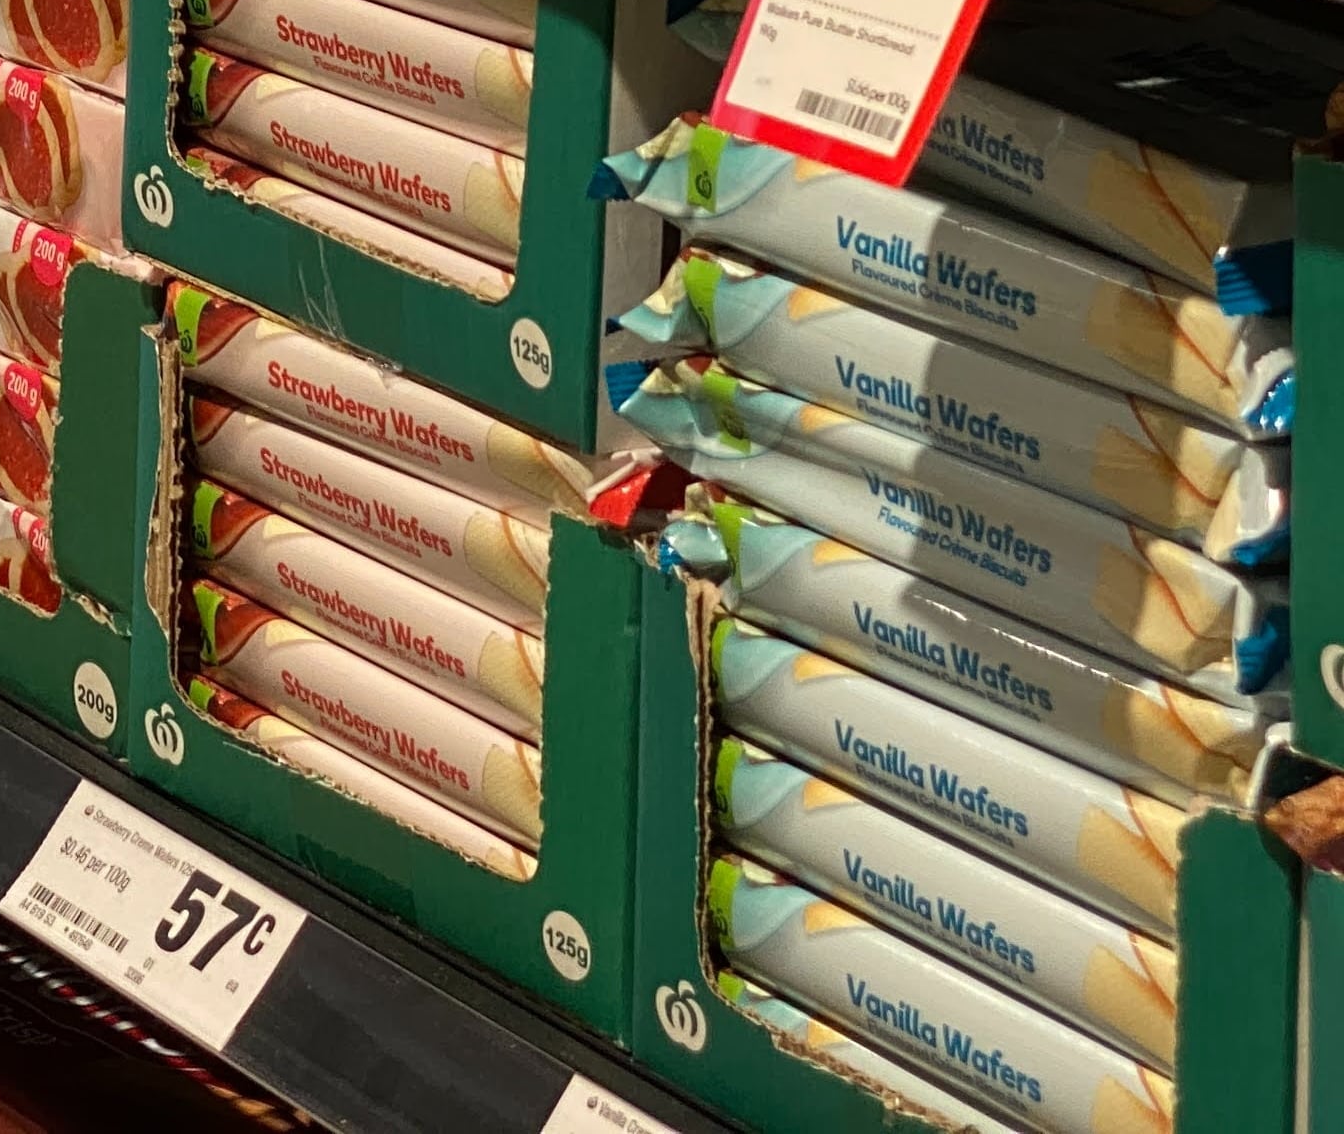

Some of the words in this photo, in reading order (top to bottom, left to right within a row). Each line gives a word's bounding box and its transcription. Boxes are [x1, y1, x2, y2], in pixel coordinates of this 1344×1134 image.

[277, 14, 385, 79] Strawberry
[270, 120, 375, 187] Strawberry
[836, 215, 930, 276] Vanilla
[936, 252, 1036, 317] Wafers
[514, 335, 550, 373] 125g
[268, 361, 386, 430] Strawberry
[835, 355, 932, 419] Vanilla
[937, 395, 1040, 462] Wafers
[260, 448, 370, 523] Strawberry
[866, 468, 953, 531] Vanilla
[956, 503, 1052, 574] Wafers
[277, 563, 387, 638] Strawberry
[853, 602, 946, 669] Vanilla
[952, 644, 1052, 712] Wafers
[78, 684, 114, 722] 200g
[835, 719, 924, 790] Vanilla
[931, 769, 1028, 838] Wafers
[60, 837, 88, 864] $0.46
[85, 855, 105, 876] per
[104, 865, 130, 893] 100g
[546, 930, 588, 967] 125g
[843, 849, 933, 921] Vanilla
[939, 899, 1034, 973] Wafers
[846, 973, 939, 1051] Vanilla
[943, 1023, 1041, 1104] Wafers
